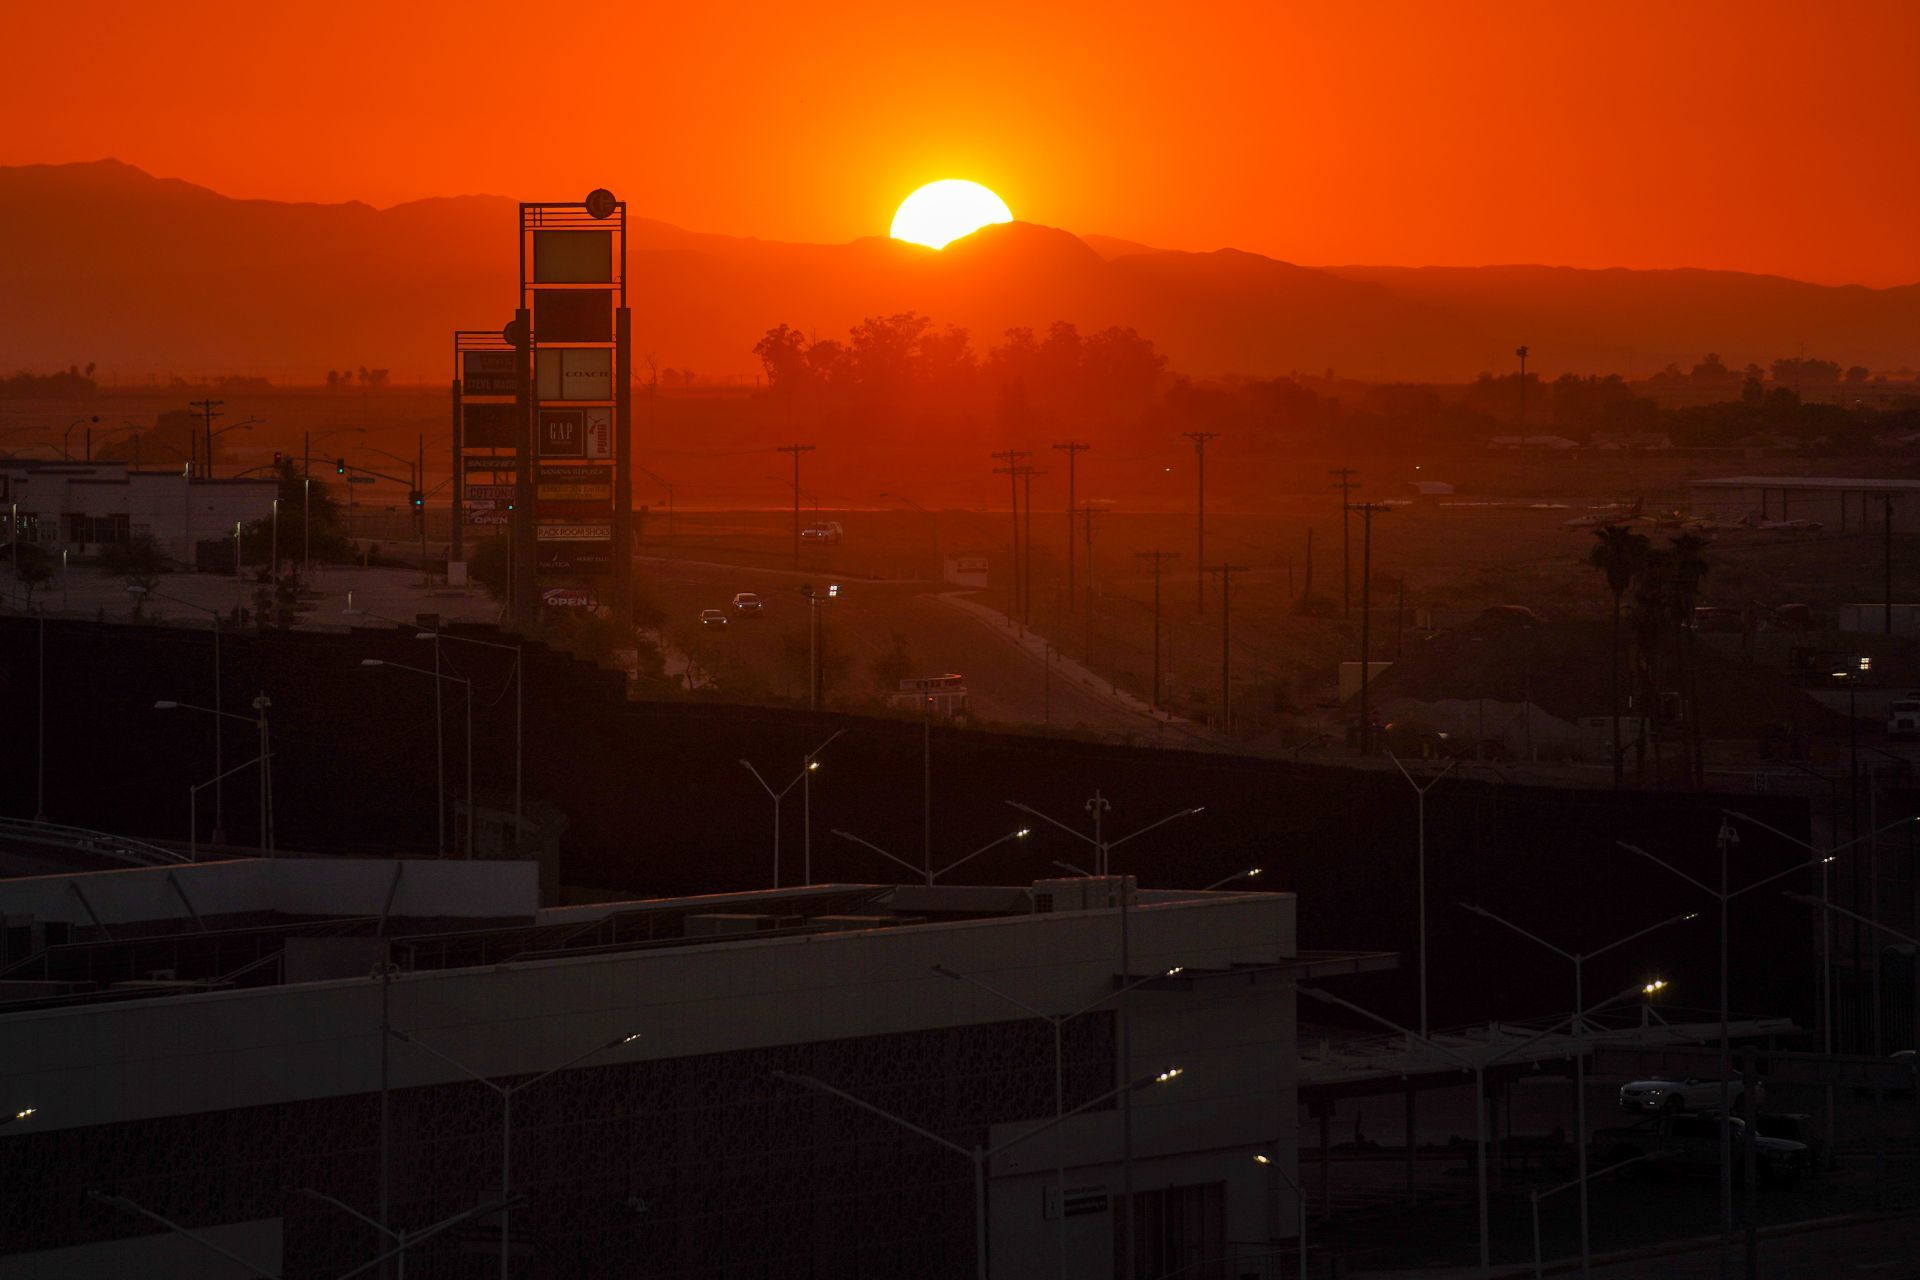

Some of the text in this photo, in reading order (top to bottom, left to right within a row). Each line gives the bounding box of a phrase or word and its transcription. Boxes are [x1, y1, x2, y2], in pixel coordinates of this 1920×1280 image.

[467, 379, 490, 389] STEVE
[550, 422, 573, 440] GAP
[597, 424, 607, 453] PUMA
[471, 487, 507, 498] COTTON
[474, 516, 508, 524] OPEN
[538, 527, 609, 536] RACK ROOM SHOES
[547, 597, 587, 606] OPEN
